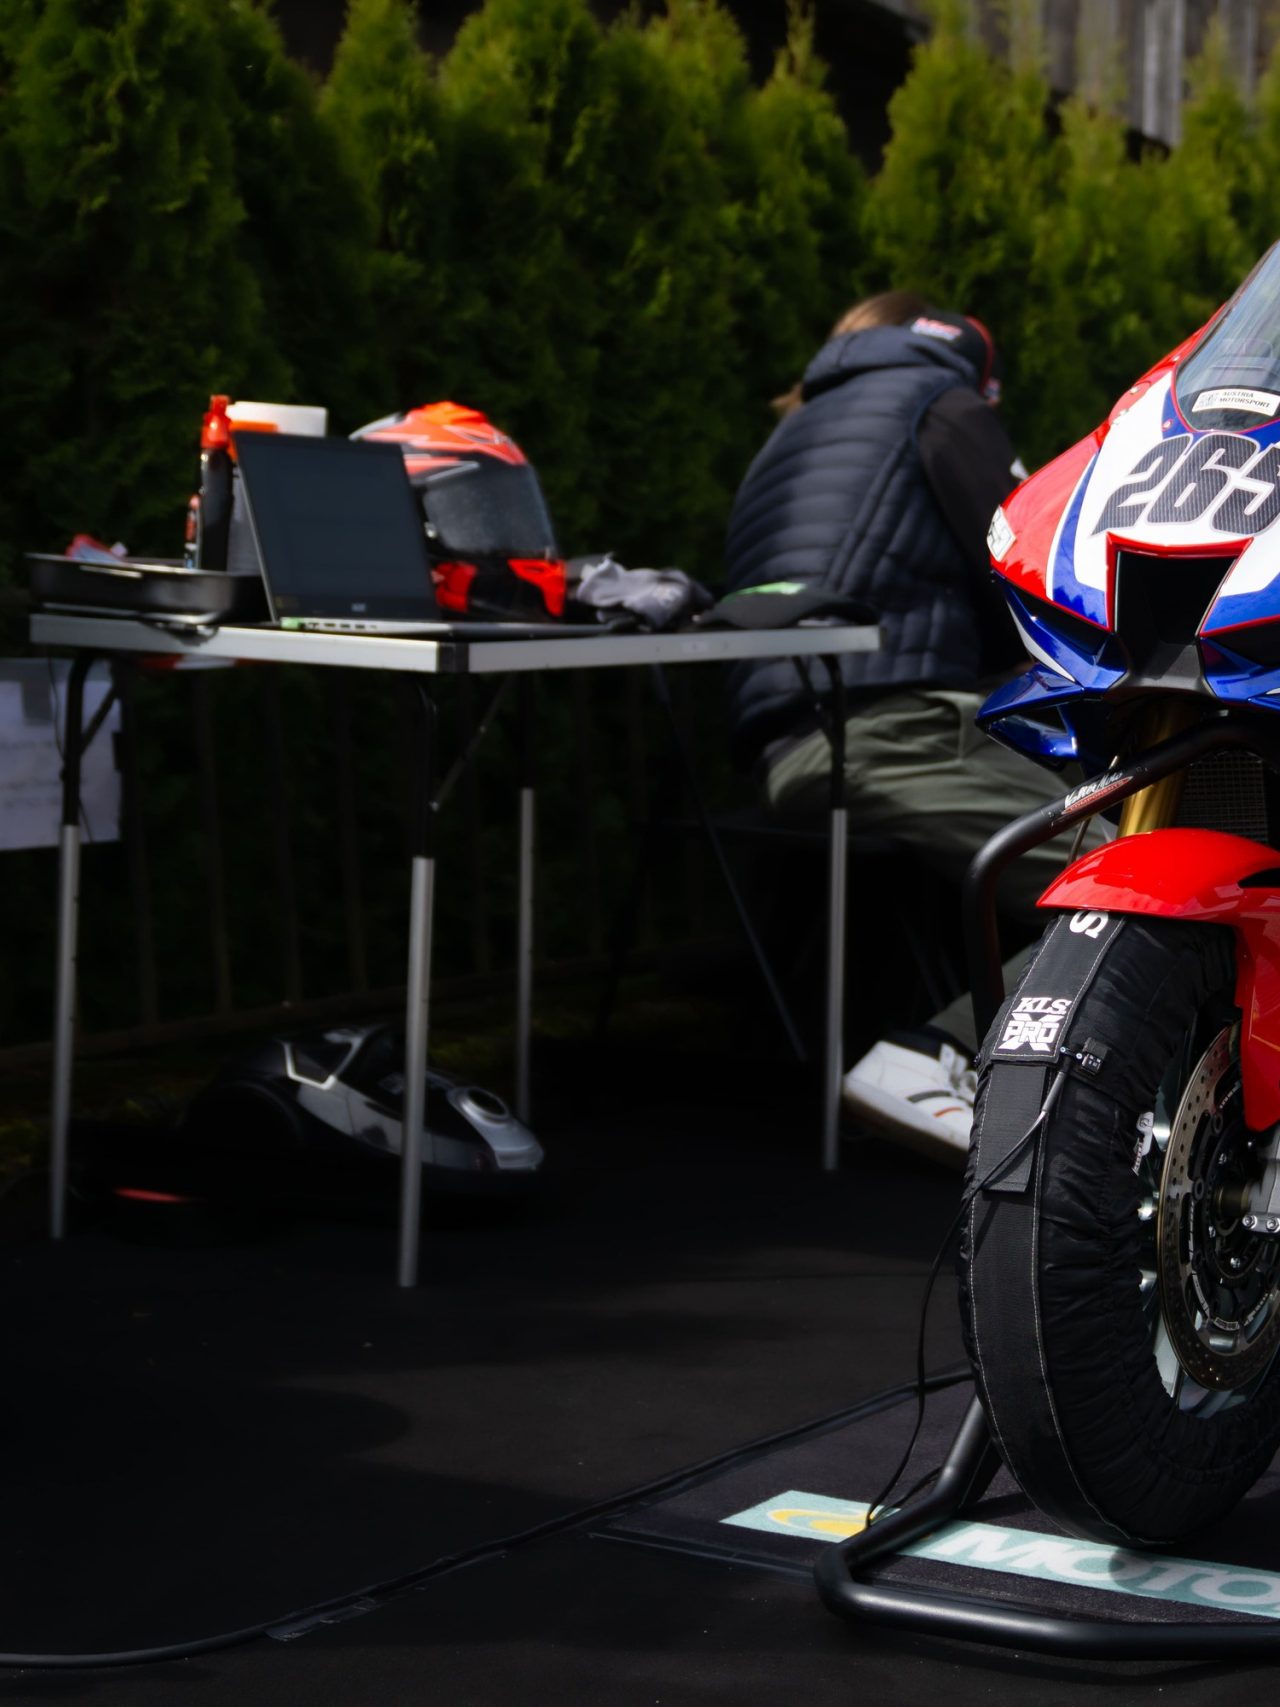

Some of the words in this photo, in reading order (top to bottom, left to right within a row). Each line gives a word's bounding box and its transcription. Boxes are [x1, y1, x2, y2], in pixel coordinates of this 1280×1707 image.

[1219, 397, 1271, 409] MOTORSPORT
[1012, 997, 1072, 1015] KLS
[1002, 1019, 1060, 1044] PRO
